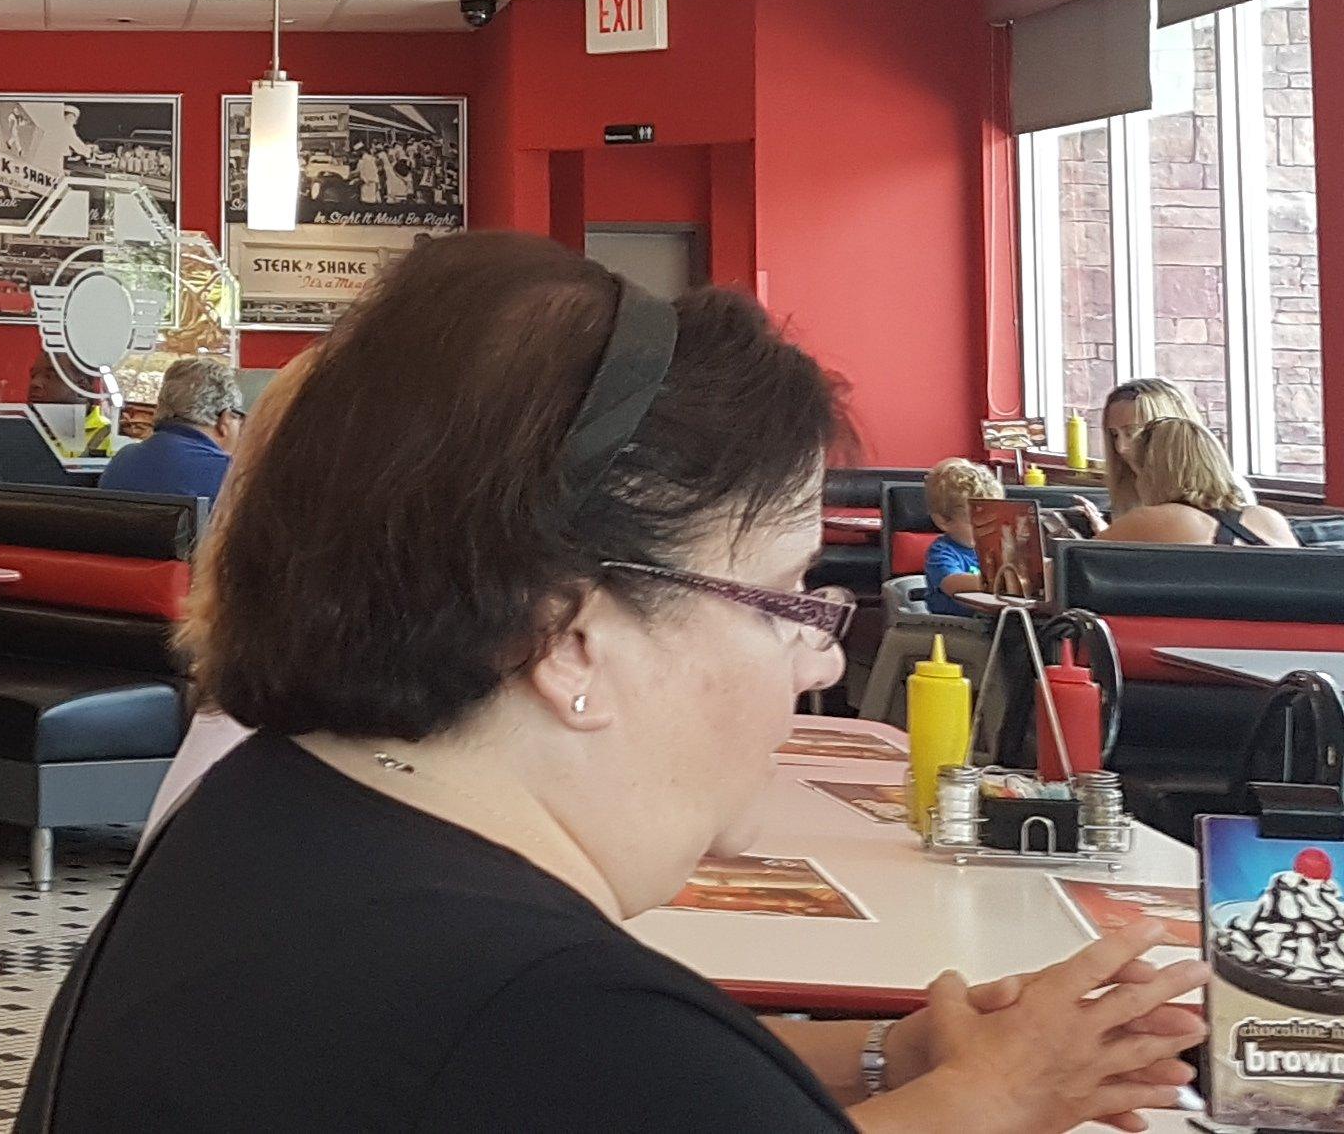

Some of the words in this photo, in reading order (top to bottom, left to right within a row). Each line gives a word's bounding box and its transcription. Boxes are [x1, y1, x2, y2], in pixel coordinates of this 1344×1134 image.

[314, 211, 325, 224] In
[328, 211, 360, 226] Sight
[374, 212, 403, 226] Must
[405, 212, 422, 226] Be
[423, 213, 458, 227] Right
[253, 258, 303, 273] STEAK
[317, 260, 367, 275] SHAKE
[1244, 1042, 1344, 1074] brown
